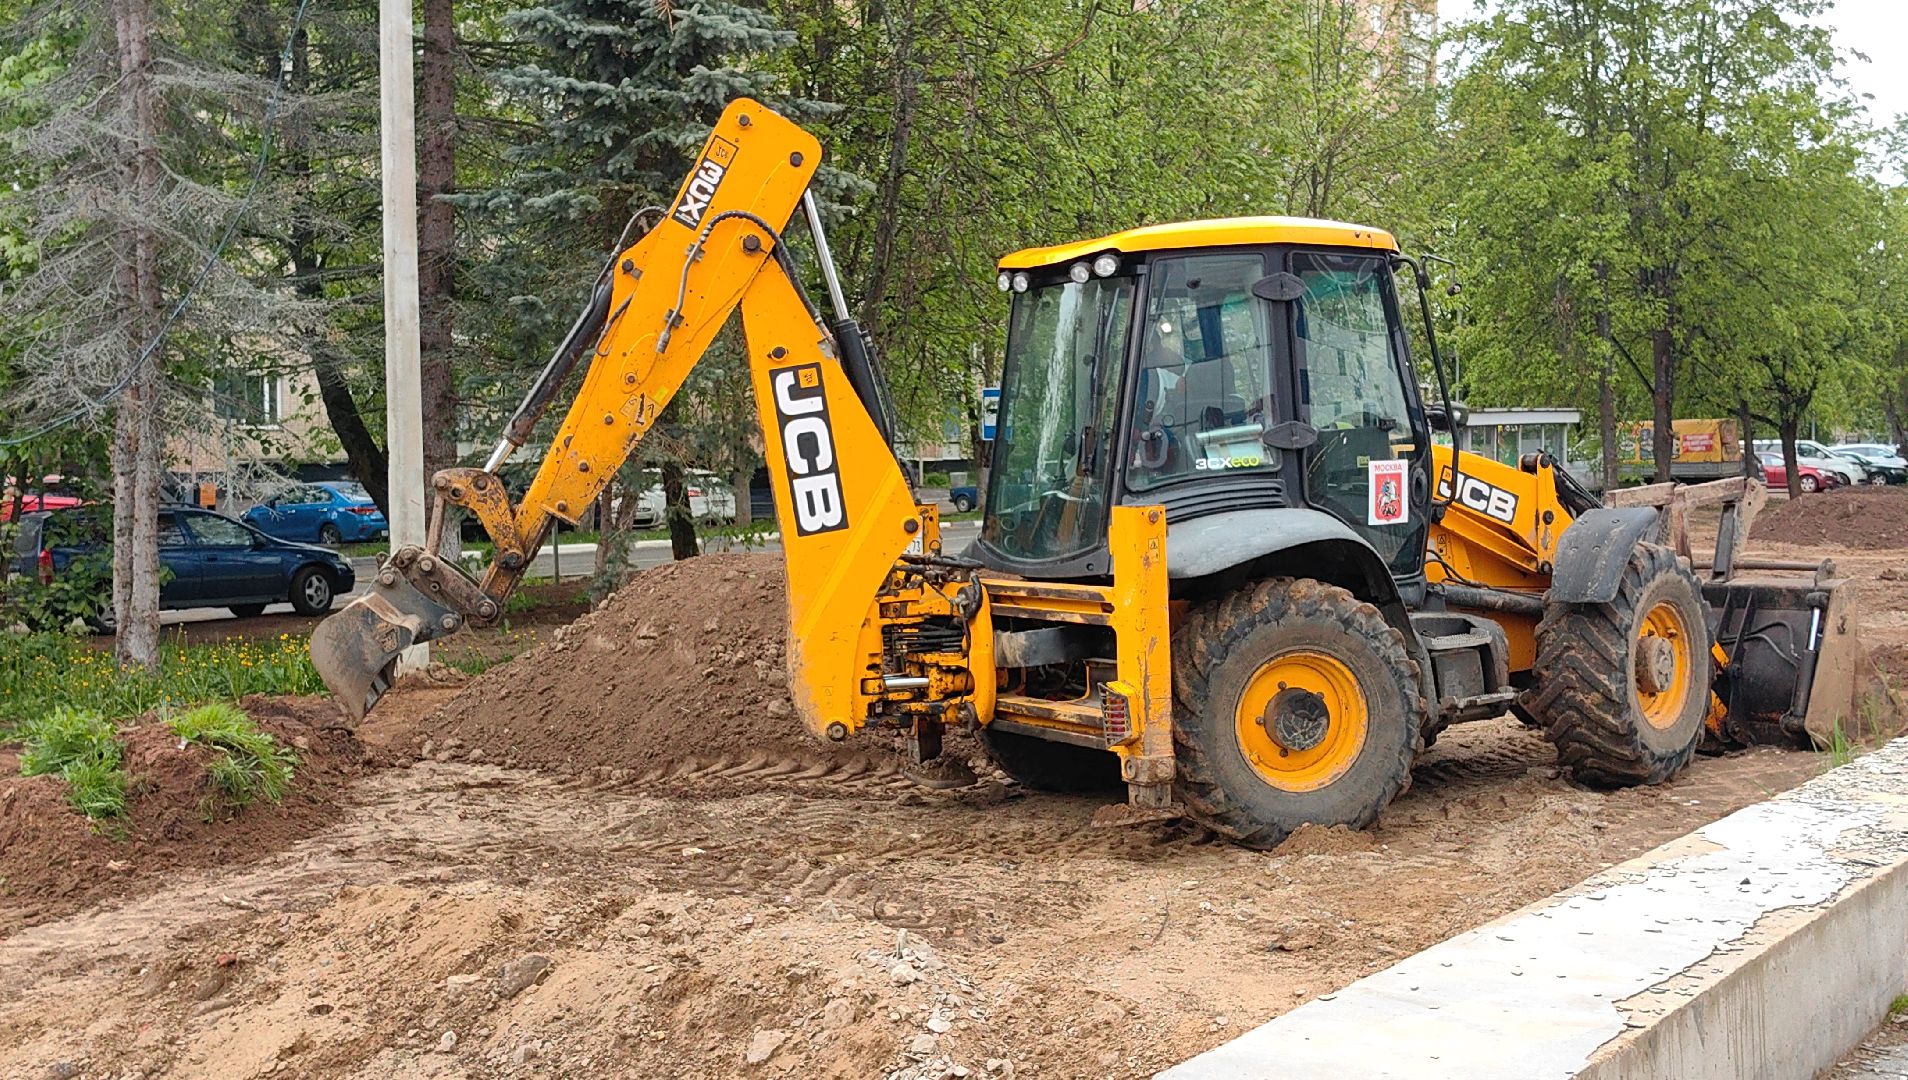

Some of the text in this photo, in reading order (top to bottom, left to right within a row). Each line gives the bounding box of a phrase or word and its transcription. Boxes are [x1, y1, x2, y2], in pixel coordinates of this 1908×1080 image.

[678, 161, 724, 221] 3CX
[775, 371, 843, 532] JCB
[1195, 456, 1260, 470] 3CXeco
[1374, 463, 1403, 472] МОСКВА
[1439, 472, 1516, 523] JCB
